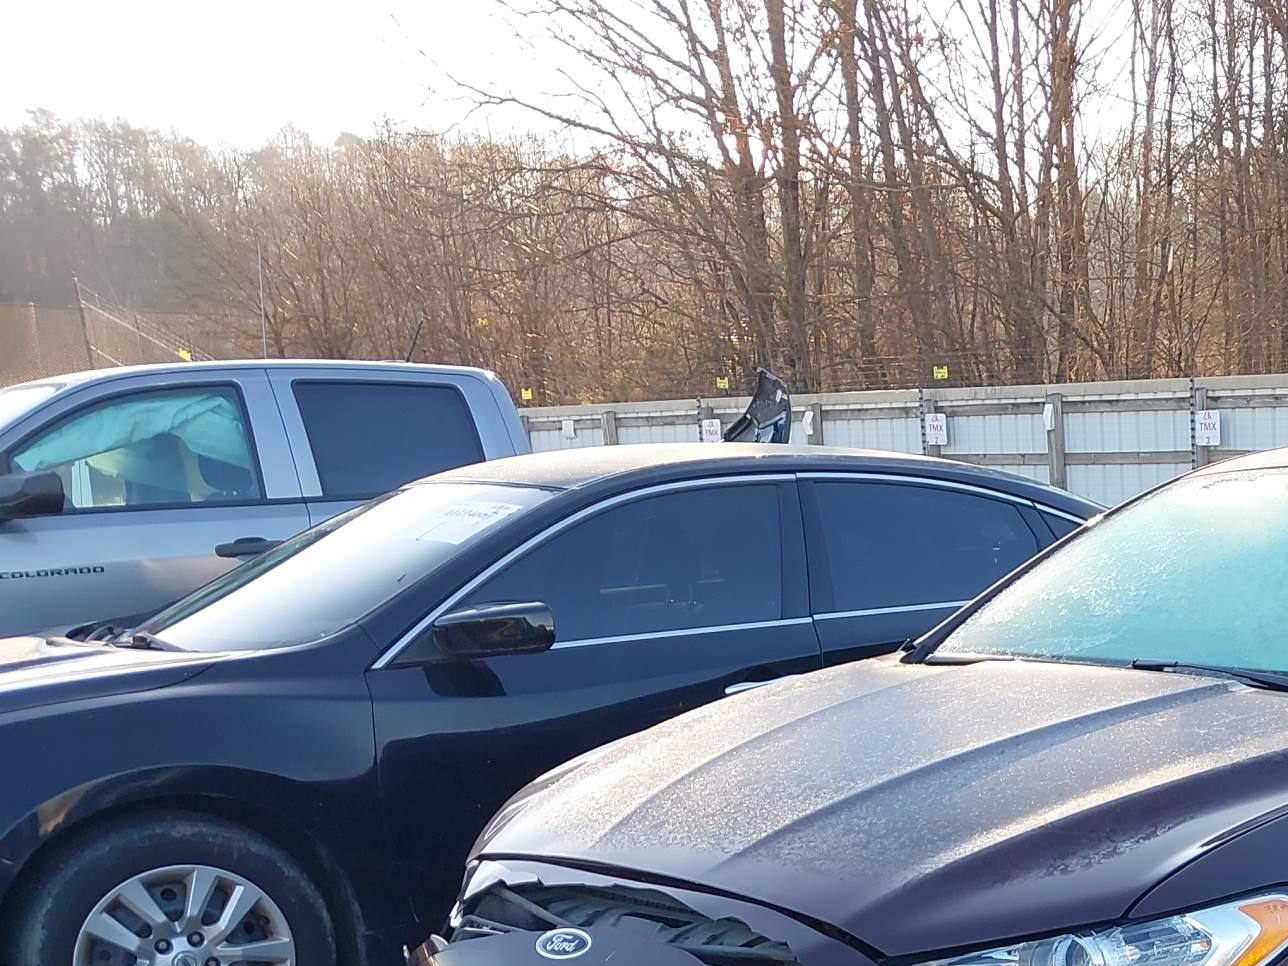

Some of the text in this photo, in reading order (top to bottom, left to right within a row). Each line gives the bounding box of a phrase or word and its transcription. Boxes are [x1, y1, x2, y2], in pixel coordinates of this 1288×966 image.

[929, 423, 944, 432] TMX
[1199, 422, 1217, 431] TMX
[0, 566, 105, 579] COLORADO
[546, 934, 580, 952] Ford
